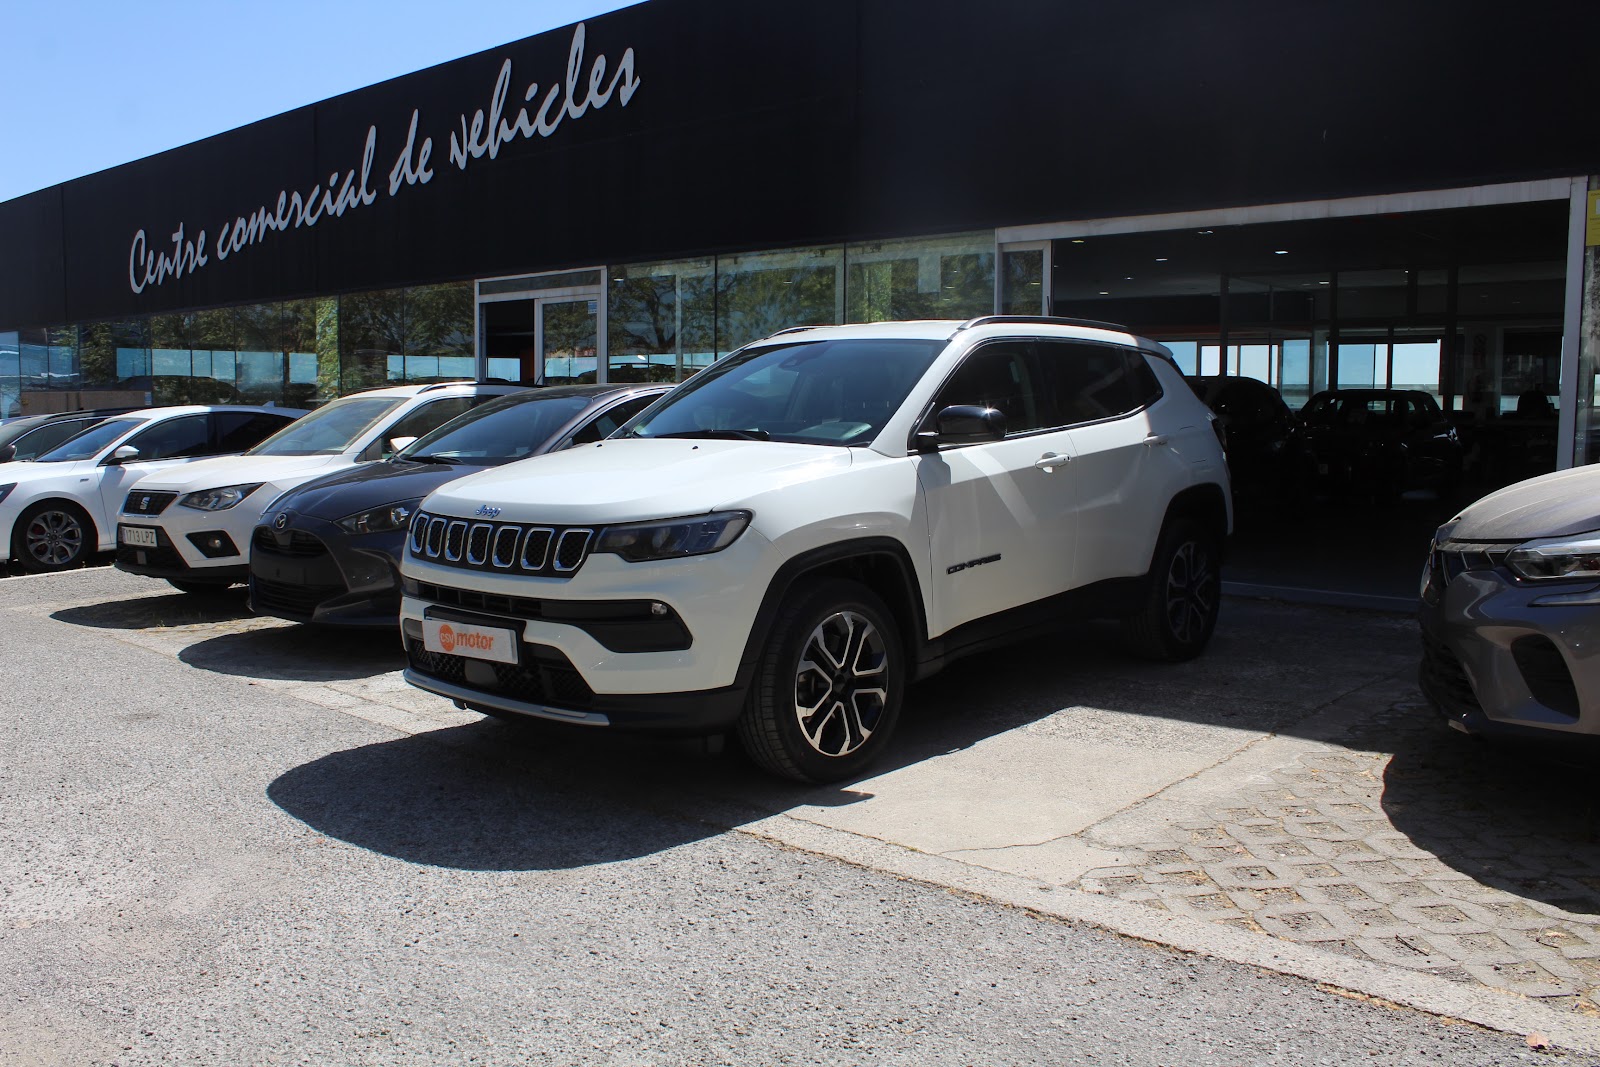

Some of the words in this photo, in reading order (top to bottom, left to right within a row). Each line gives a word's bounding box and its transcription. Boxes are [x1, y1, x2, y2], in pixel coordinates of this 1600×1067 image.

[129, 222, 208, 294] Centre
[216, 125, 377, 261] comercial
[388, 109, 434, 196] de
[449, 22, 641, 170] vehicles
[475, 504, 502, 519] Jeep
[456, 632, 494, 650] motor
